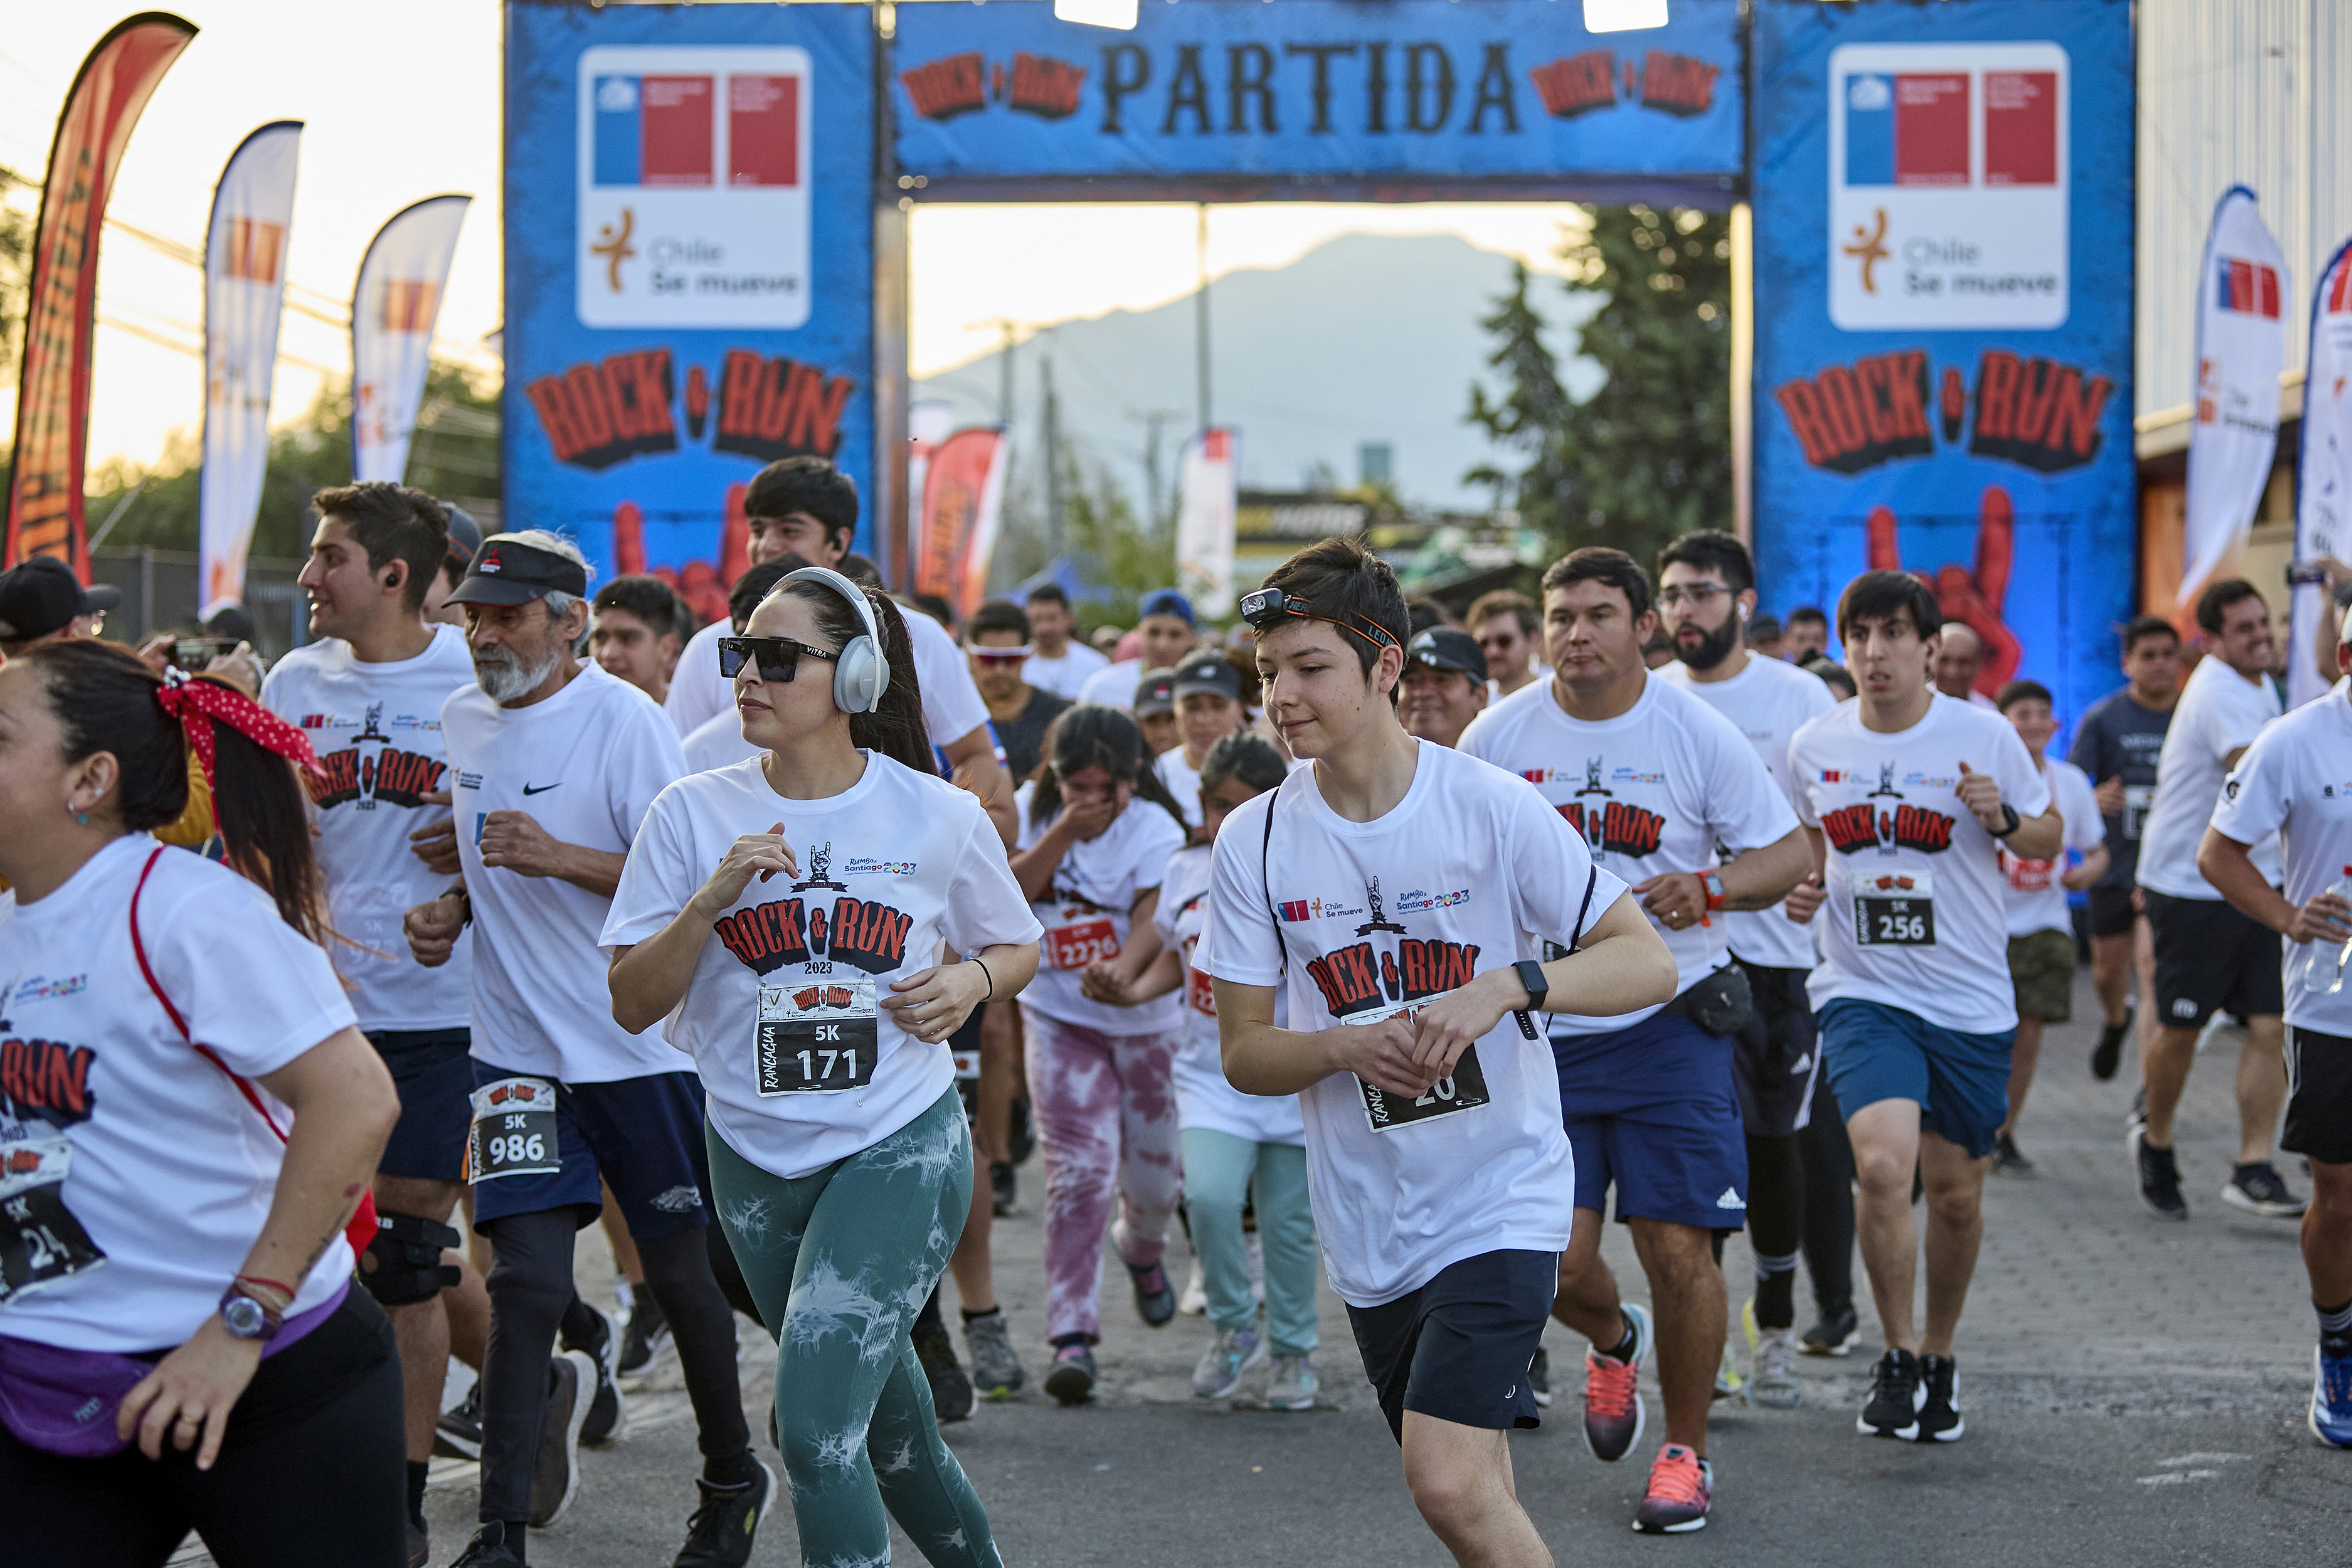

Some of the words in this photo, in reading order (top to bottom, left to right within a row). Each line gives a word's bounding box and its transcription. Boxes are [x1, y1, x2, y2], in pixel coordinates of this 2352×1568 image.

[1098, 42, 1521, 135] PARTIDA
[648, 237, 724, 264] Chile
[1904, 236, 1979, 263] Chile
[650, 272, 686, 294] Se
[697, 274, 797, 295] mueve
[1905, 270, 1941, 295] Se
[1952, 273, 2058, 295] mueve
[526, 347, 677, 470] ROCK
[714, 347, 854, 461] RUN
[1775, 347, 1935, 475] ROCK
[1969, 347, 2114, 472] RUN
[1368, 625, 1386, 644] LED
[807, 646, 827, 659] VITRA
[375, 748, 447, 807] RUN
[1603, 802, 1666, 857] RUN
[1821, 803, 1880, 854] ROCK
[1894, 803, 1956, 854] RUN
[883, 862, 917, 876] 2023
[1325, 903, 1343, 911] Chile
[1337, 908, 1364, 916] mueve
[1396, 899, 1434, 910] Santiago
[1434, 889, 1470, 909] 2023
[714, 898, 810, 973] ROCK
[810, 908, 827, 954] &
[829, 898, 914, 973] RUN
[1878, 915, 1926, 941] 256
[804, 961, 833, 975] 2023
[1381, 951, 1399, 1001] &
[1399, 939, 1481, 1001] RUN
[792, 987, 822, 1012] ROCK
[826, 986, 854, 1010] RUN
[815, 1024, 841, 1042] 5K
[761, 1025, 780, 1089] RANCAGUA
[796, 1049, 857, 1081] 171
[1, 1038, 95, 1126] RUN
[504, 1114, 527, 1130] 5K
[489, 1133, 546, 1166] 986
